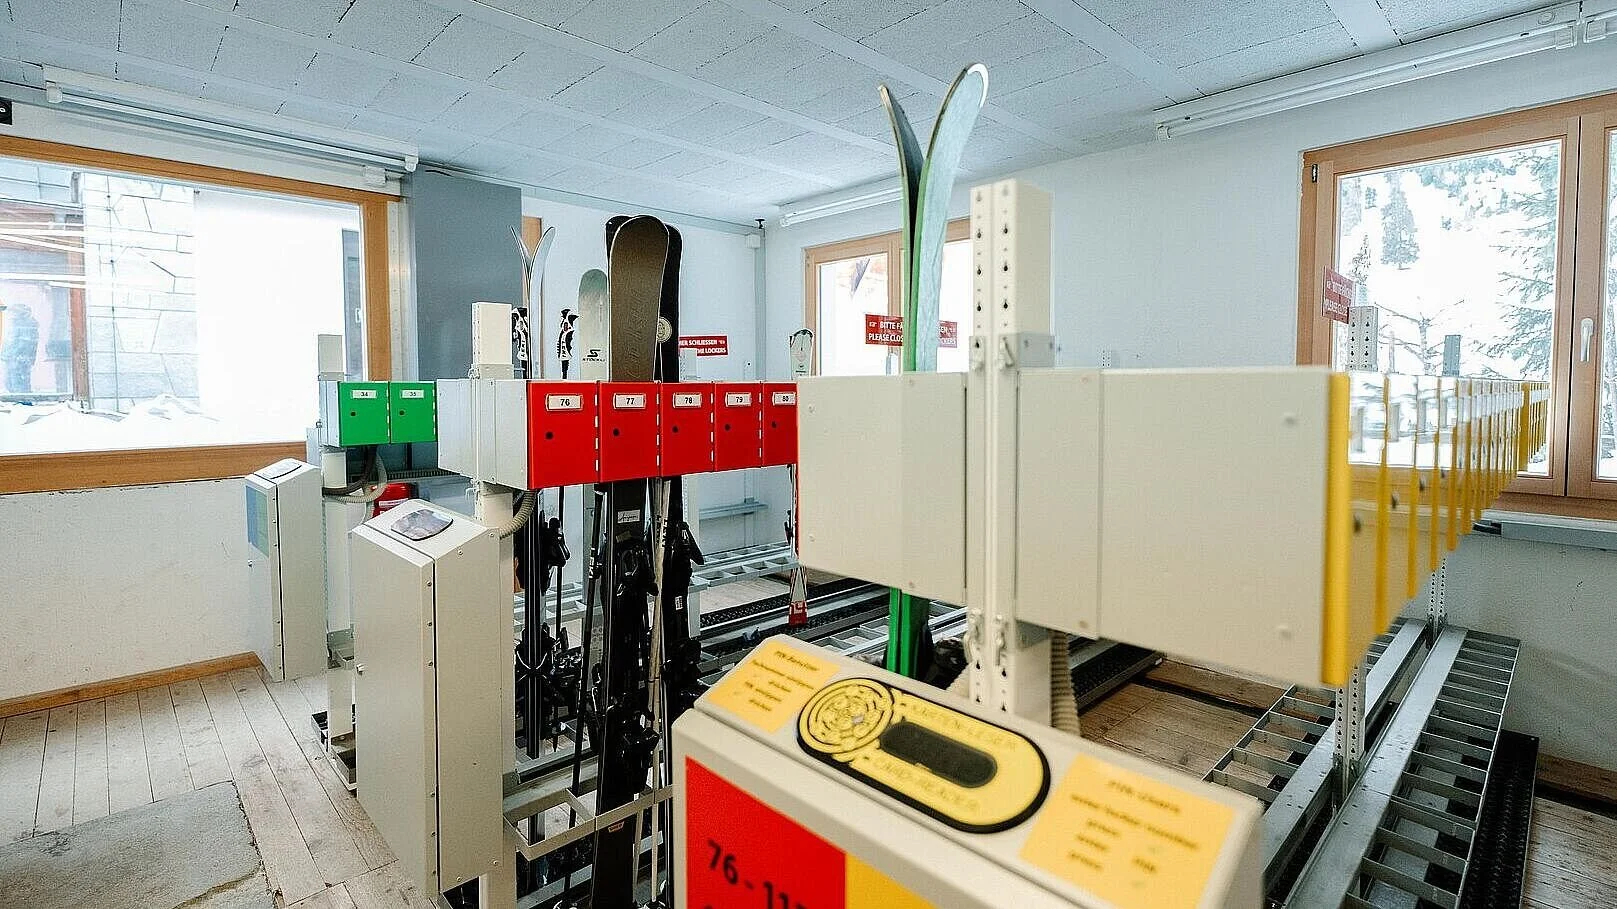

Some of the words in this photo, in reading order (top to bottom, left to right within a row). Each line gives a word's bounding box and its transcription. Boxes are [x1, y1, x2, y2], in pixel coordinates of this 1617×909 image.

[880, 321, 896, 329] BITTE
[869, 333, 889, 341] PLEASE
[890, 334, 904, 342] CLOS
[560, 398, 570, 407] 76
[707, 838, 739, 885] 76
[763, 881, 808, 909] 11
